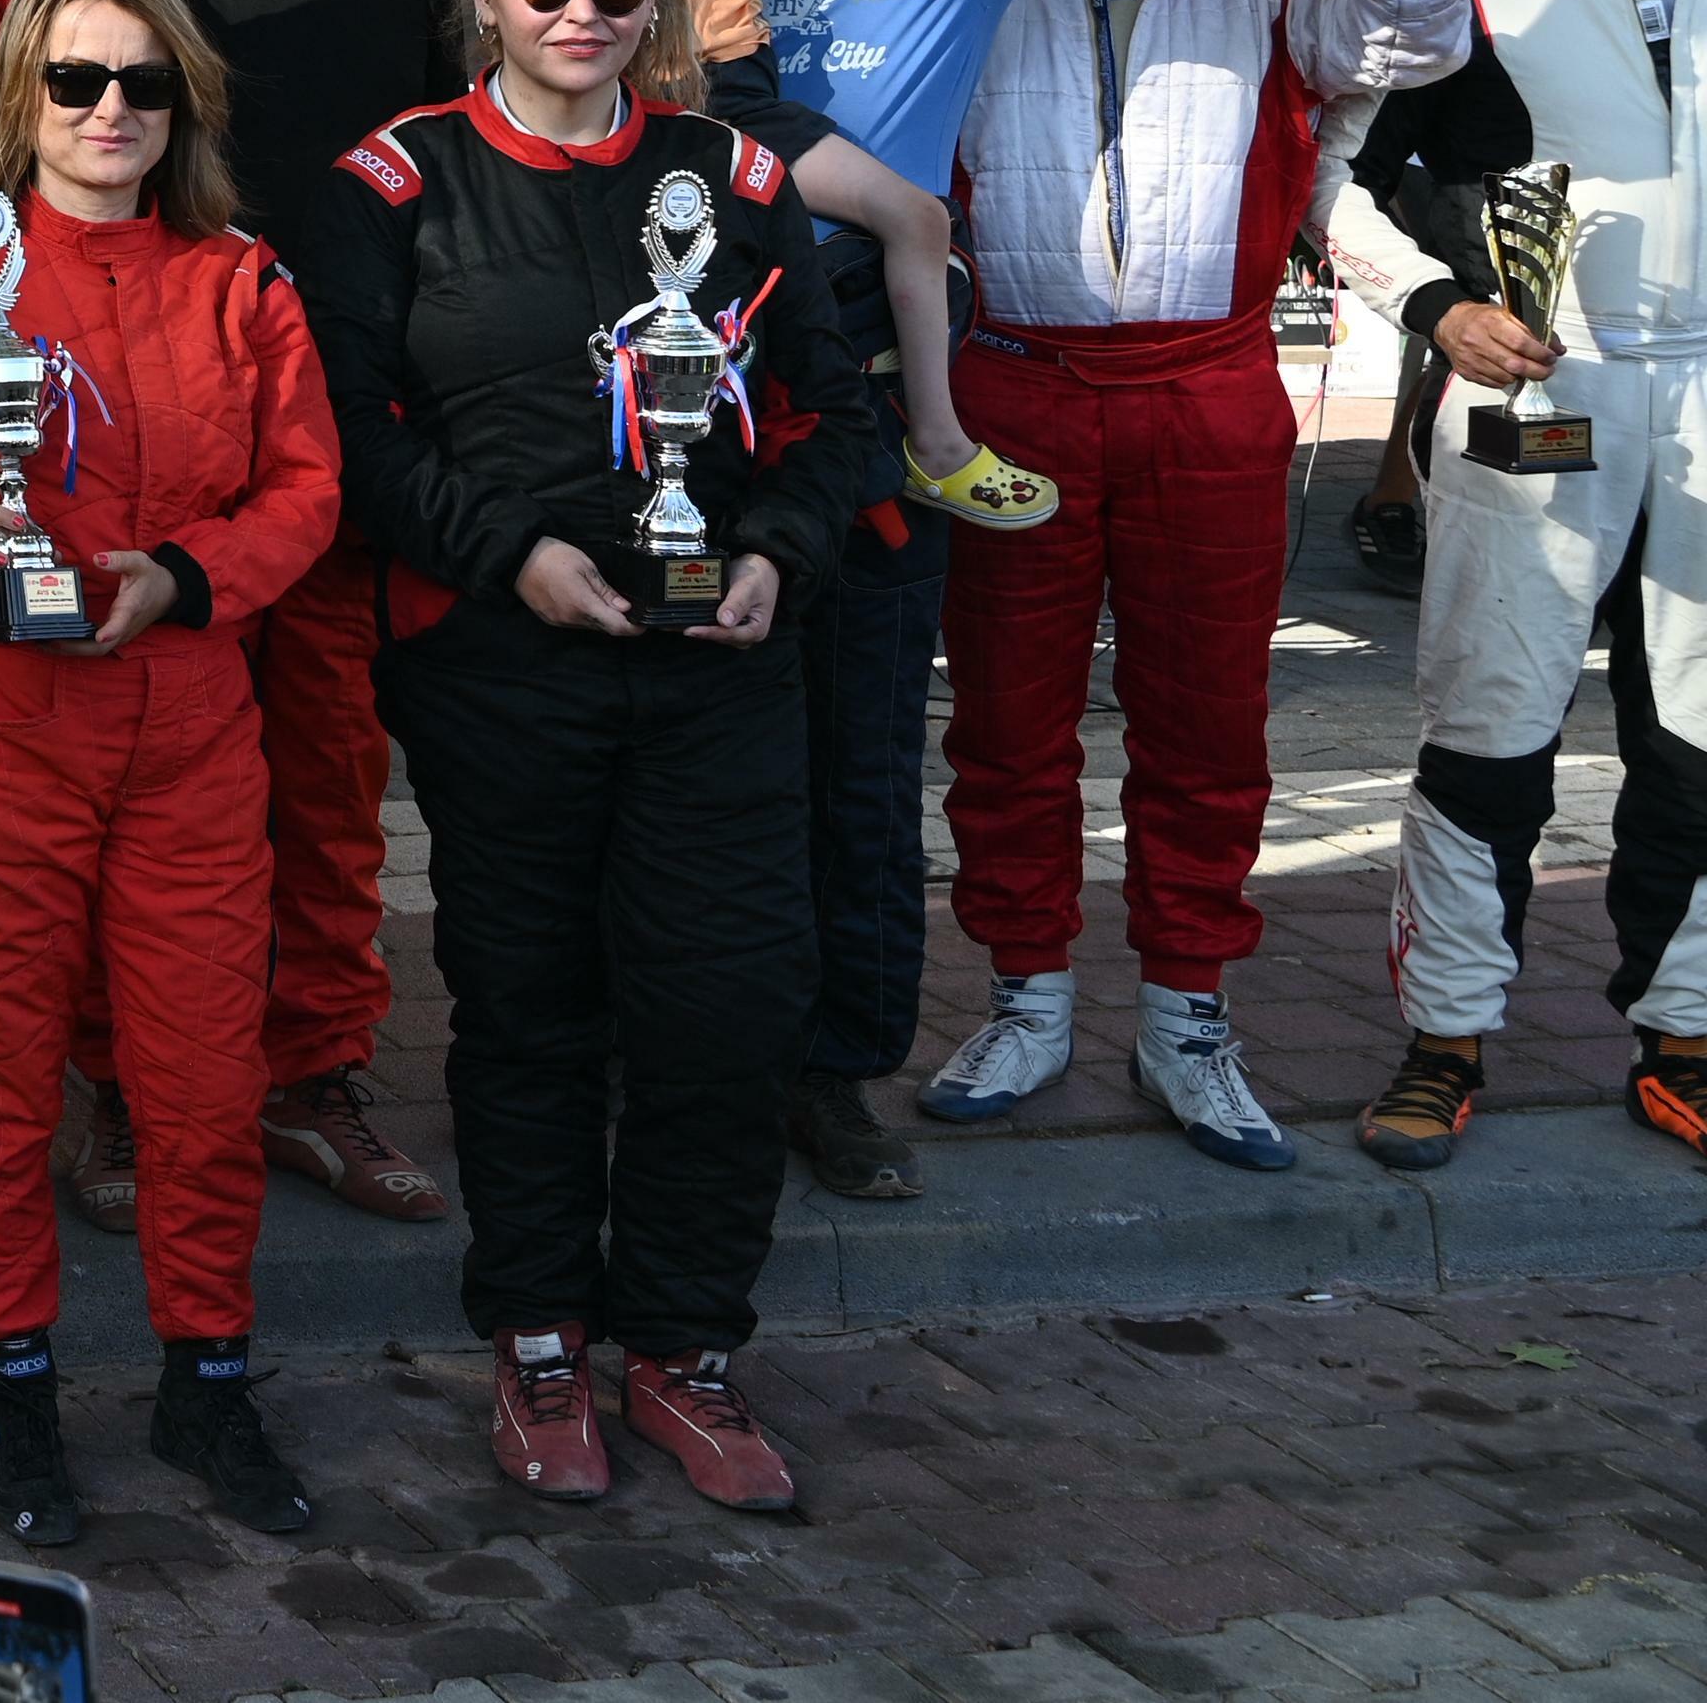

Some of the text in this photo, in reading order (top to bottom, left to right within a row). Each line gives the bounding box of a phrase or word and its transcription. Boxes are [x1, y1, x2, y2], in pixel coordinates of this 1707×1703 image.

[821, 39, 886, 79] City
[347, 148, 404, 192] sparco
[747, 144, 774, 192] spar
[974, 328, 1025, 354] parco
[990, 991, 1015, 1005] OMP
